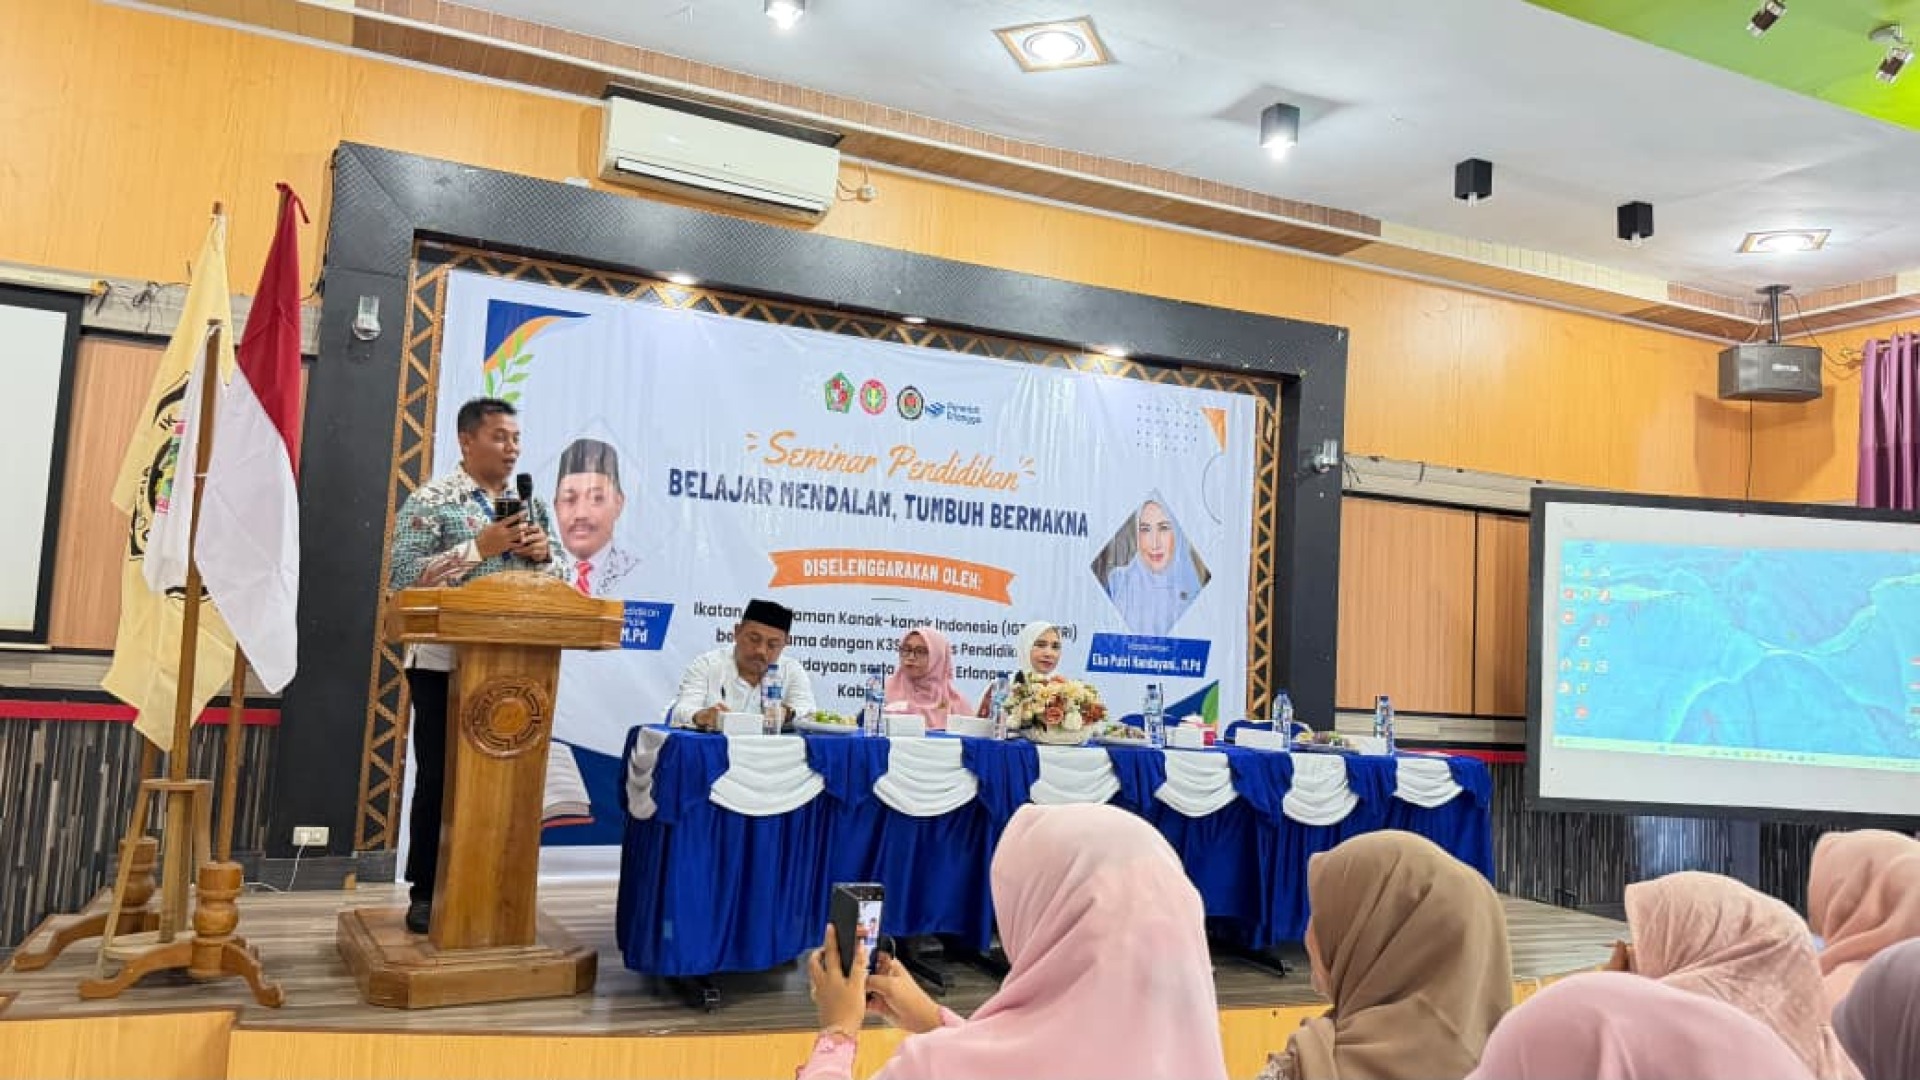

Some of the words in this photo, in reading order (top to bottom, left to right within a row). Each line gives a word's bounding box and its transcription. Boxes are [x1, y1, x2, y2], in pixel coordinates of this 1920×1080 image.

[764, 430, 877, 473] Seminar
[888, 445, 1019, 491] Pendidikan
[668, 468, 774, 506] BELAJAR
[780, 480, 897, 522] MENDALAM,
[904, 493, 985, 527] TUMBUH
[990, 503, 1088, 537] BERMAKNA
[803, 558, 939, 583] DISELENGGARAKAN
[943, 567, 983, 591] OLEH:
[694, 600, 743, 617] Ikatan
[792, 611, 835, 624] aman
[935, 616, 998, 634] Indonesia
[820, 635, 873, 654] dengan
[961, 642, 1017, 657] Pendidik
